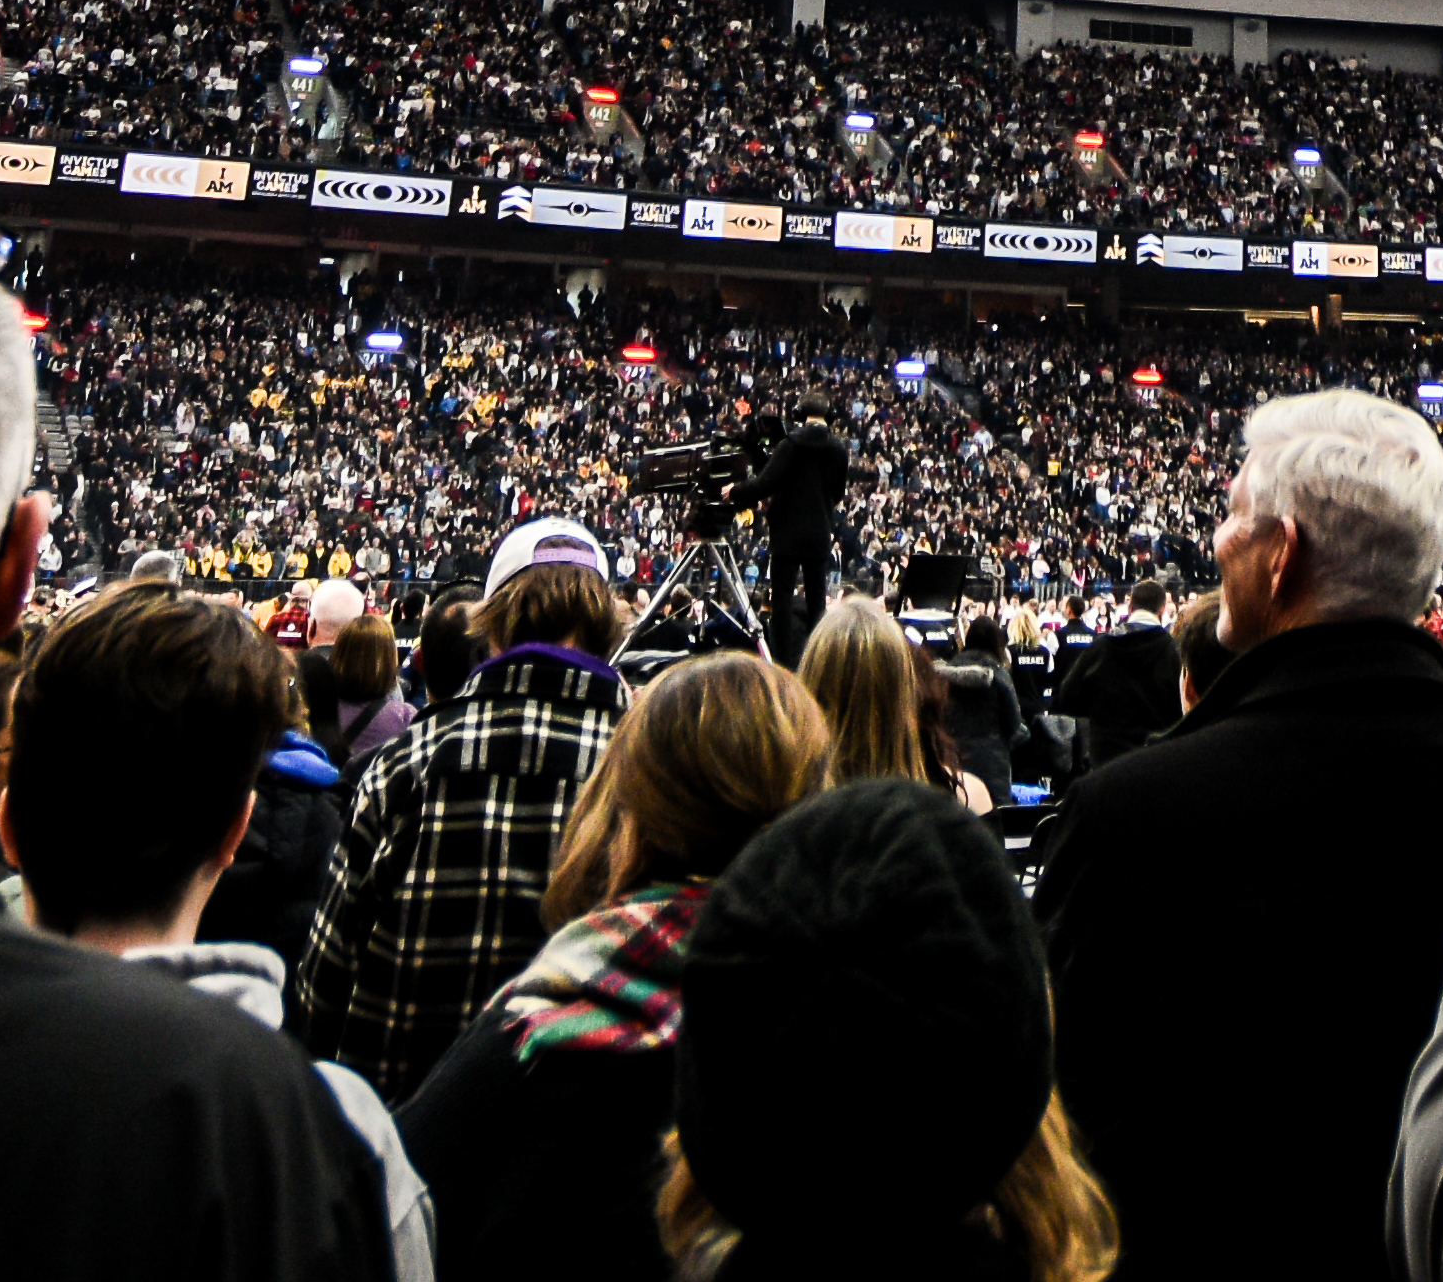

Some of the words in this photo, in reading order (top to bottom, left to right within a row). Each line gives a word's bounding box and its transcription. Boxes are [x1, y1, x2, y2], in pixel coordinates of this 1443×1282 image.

[292, 78, 313, 91] 441
[590, 108, 609, 121] 442
[849, 132, 867, 145] 443
[59, 155, 119, 169] INVICTUS
[1080, 151, 1096, 162] 444
[62, 166, 107, 178] GAMES
[219, 167, 226, 180] I
[254, 170, 309, 185] INVICTUS
[205, 181, 233, 194] AM
[256, 182, 298, 194] GAMES
[472, 185, 480, 199] I
[459, 198, 487, 214] AM
[631, 202, 680, 214] INVICTUS
[701, 206, 708, 218] I
[634, 212, 670, 223] GAMES
[786, 215, 832, 227] INVICTUS
[691, 219, 714, 231] AM
[788, 223, 823, 234] GAMES
[910, 224, 915, 235] I
[936, 226, 980, 238] INVICTUS
[901, 236, 921, 247] AM
[939, 234, 973, 246] GAMES
[1113, 235, 1120, 246] I
[1104, 245, 1127, 260] AM
[1248, 245, 1289, 258] INVICTUS
[1308, 247, 1312, 259] I
[1382, 252, 1422, 263] INVICTUS
[1250, 254, 1282, 267] GAMES
[1300, 258, 1319, 269] AM
[1384, 260, 1415, 271] GAMES
[1018, 656, 1044, 665] ISRAEL
